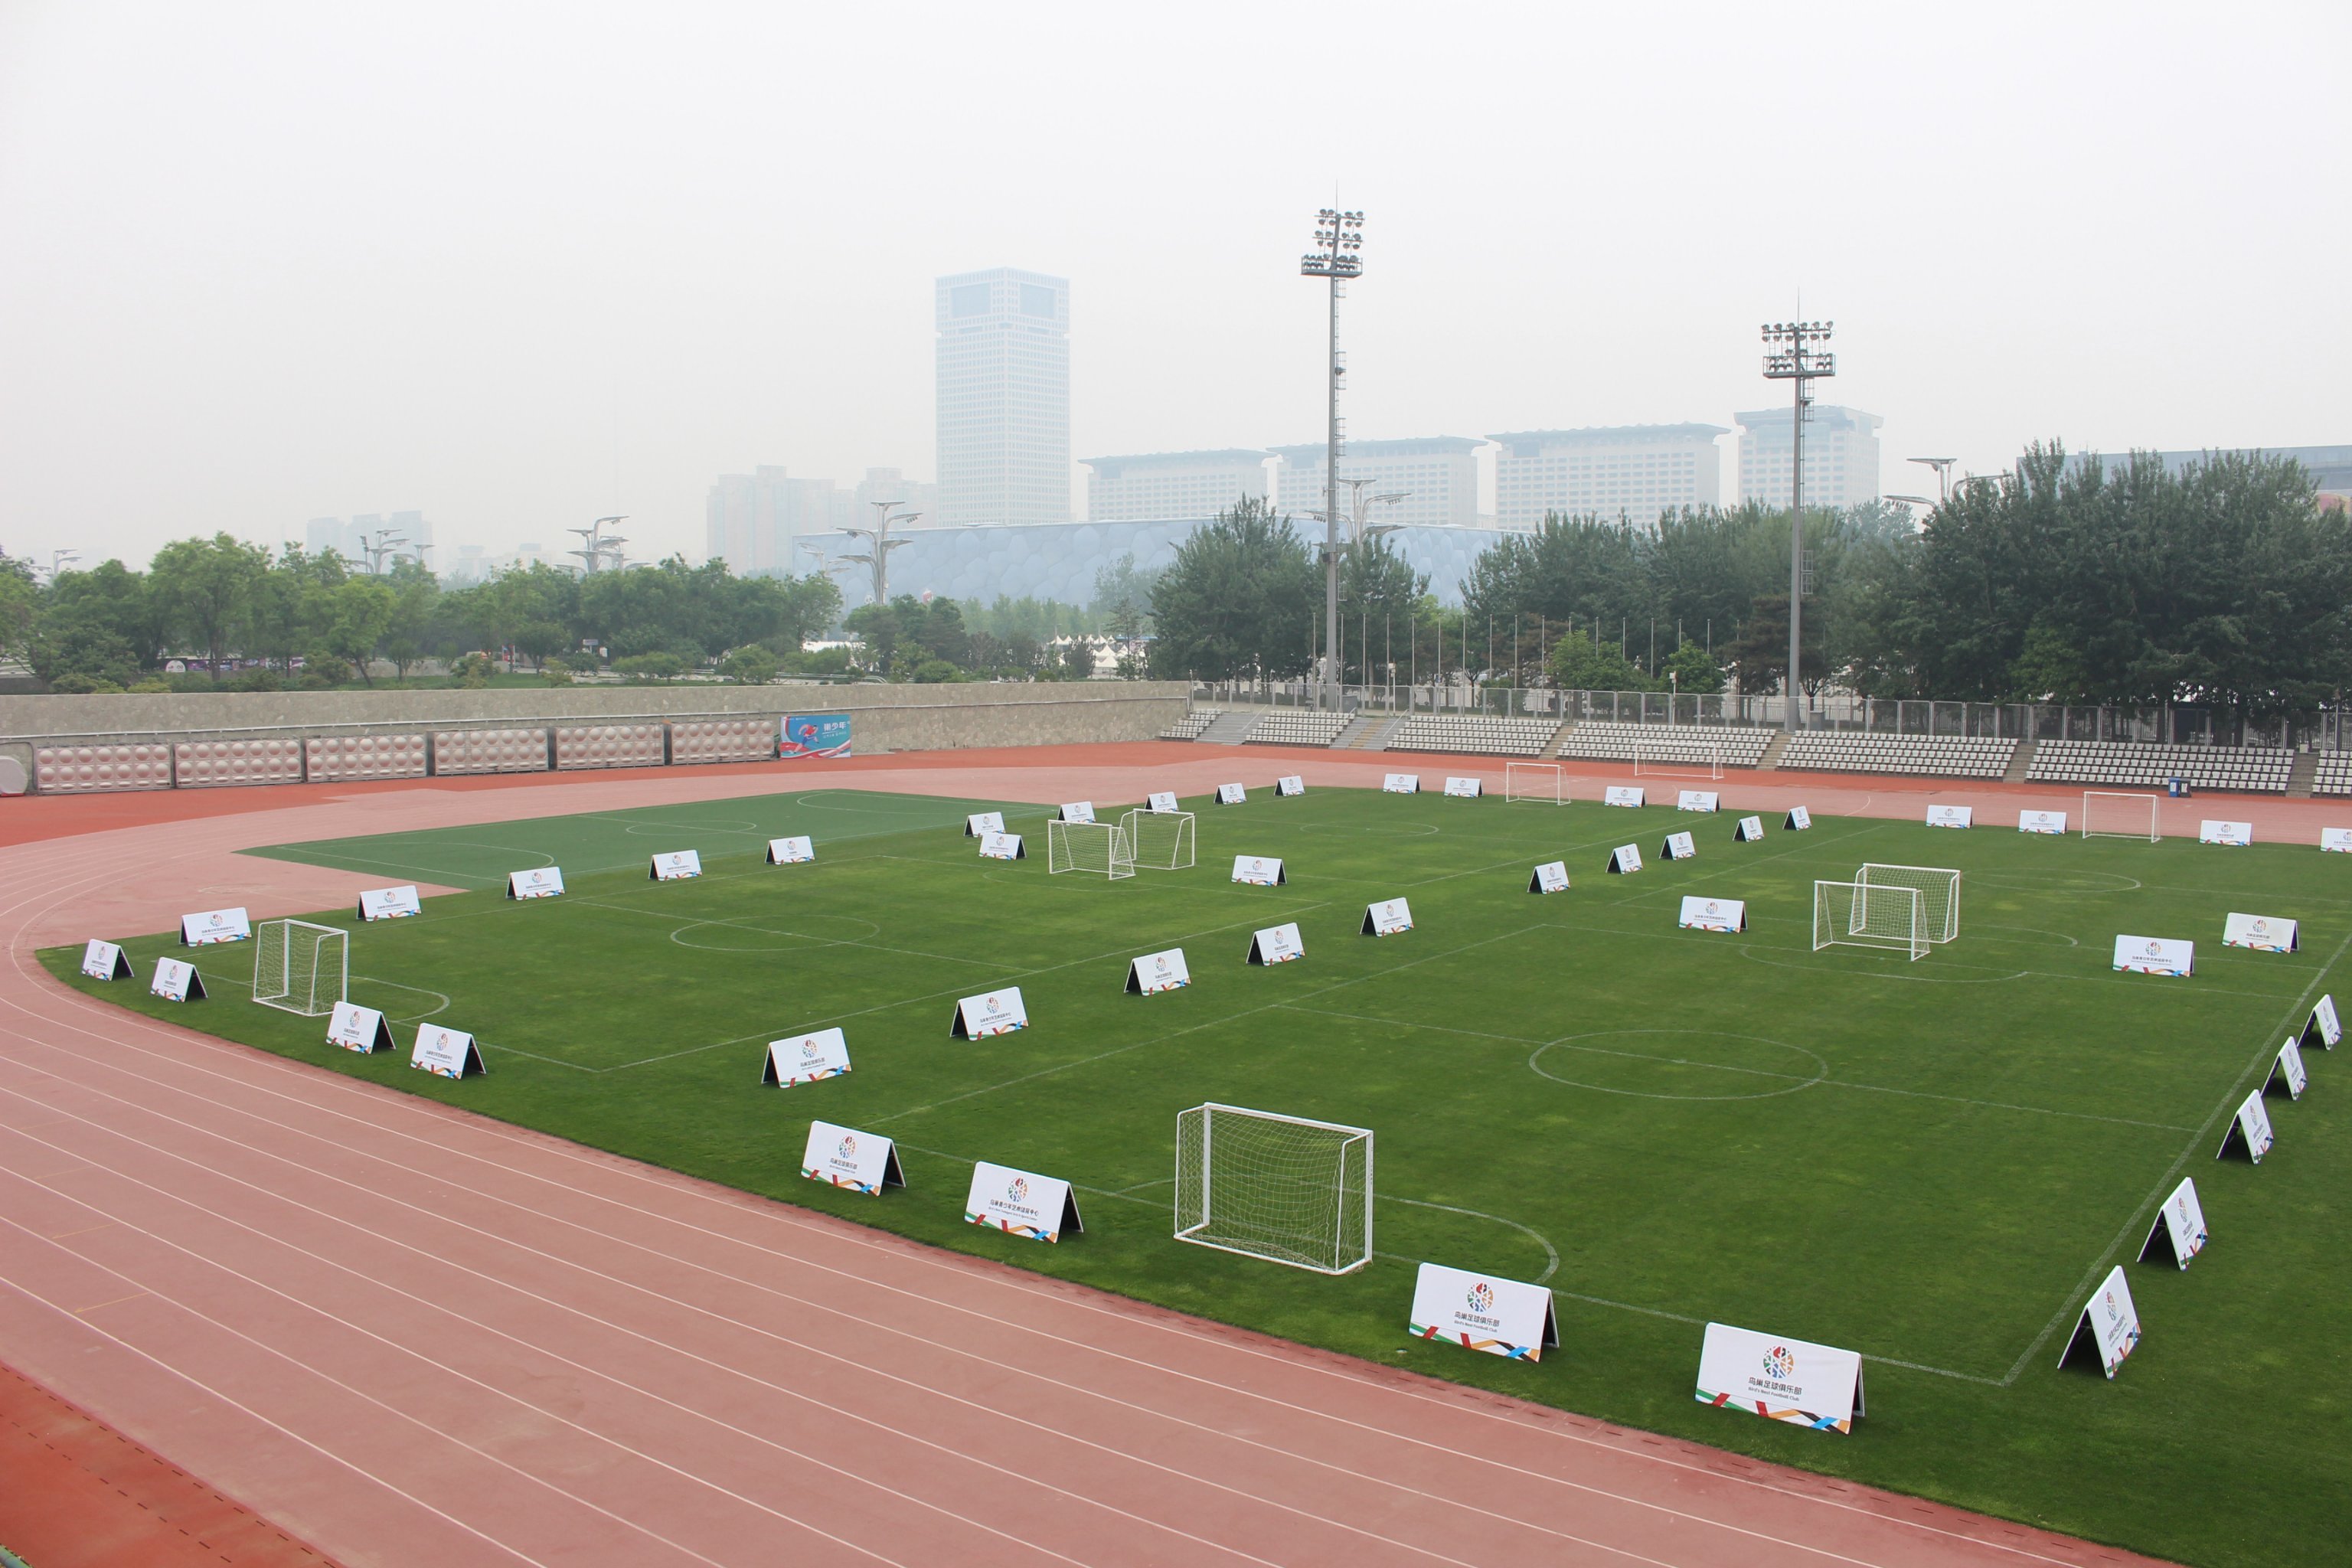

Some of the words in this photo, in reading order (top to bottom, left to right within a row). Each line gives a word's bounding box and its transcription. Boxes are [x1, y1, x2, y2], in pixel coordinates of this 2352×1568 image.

[1748, 1377, 1802, 1395] 鸟巢足球俱乐部
